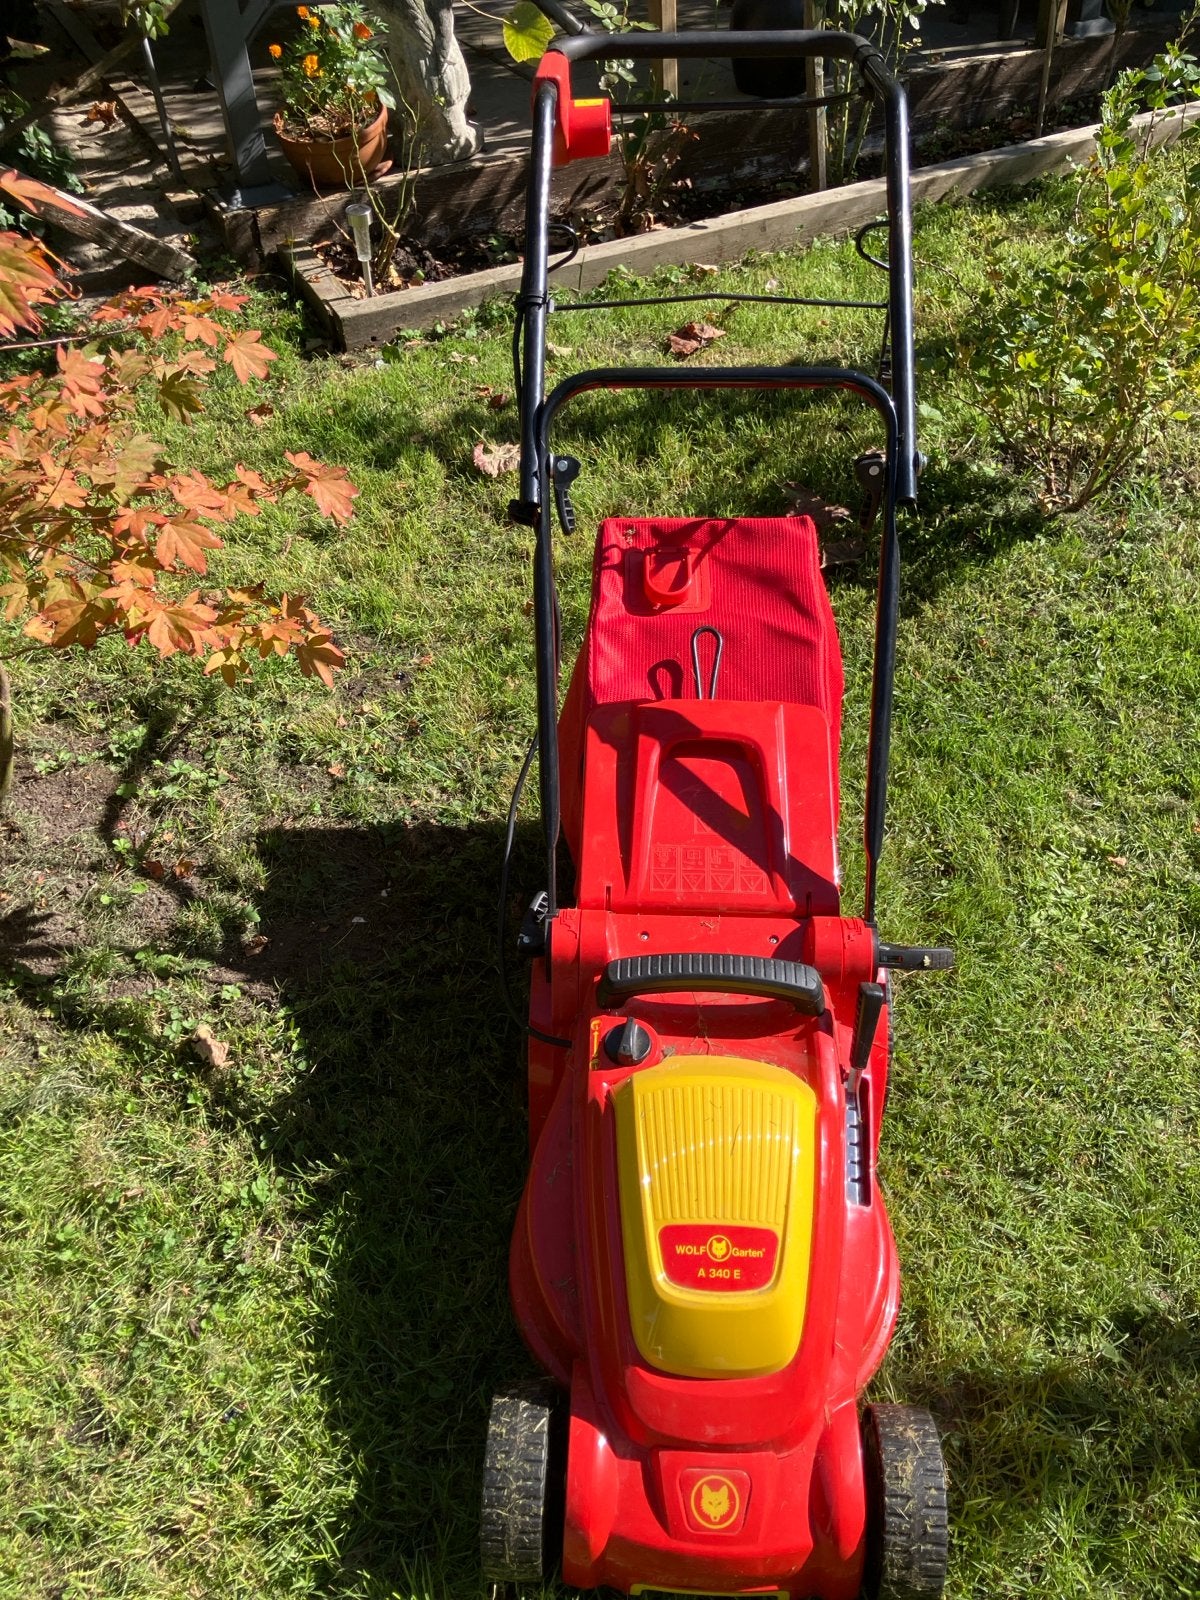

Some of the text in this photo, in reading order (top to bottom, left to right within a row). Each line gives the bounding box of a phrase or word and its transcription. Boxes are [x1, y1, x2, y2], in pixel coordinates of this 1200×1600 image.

[675, 1245, 707, 1255] WOLF
[697, 1268, 741, 1279] A 340 E
